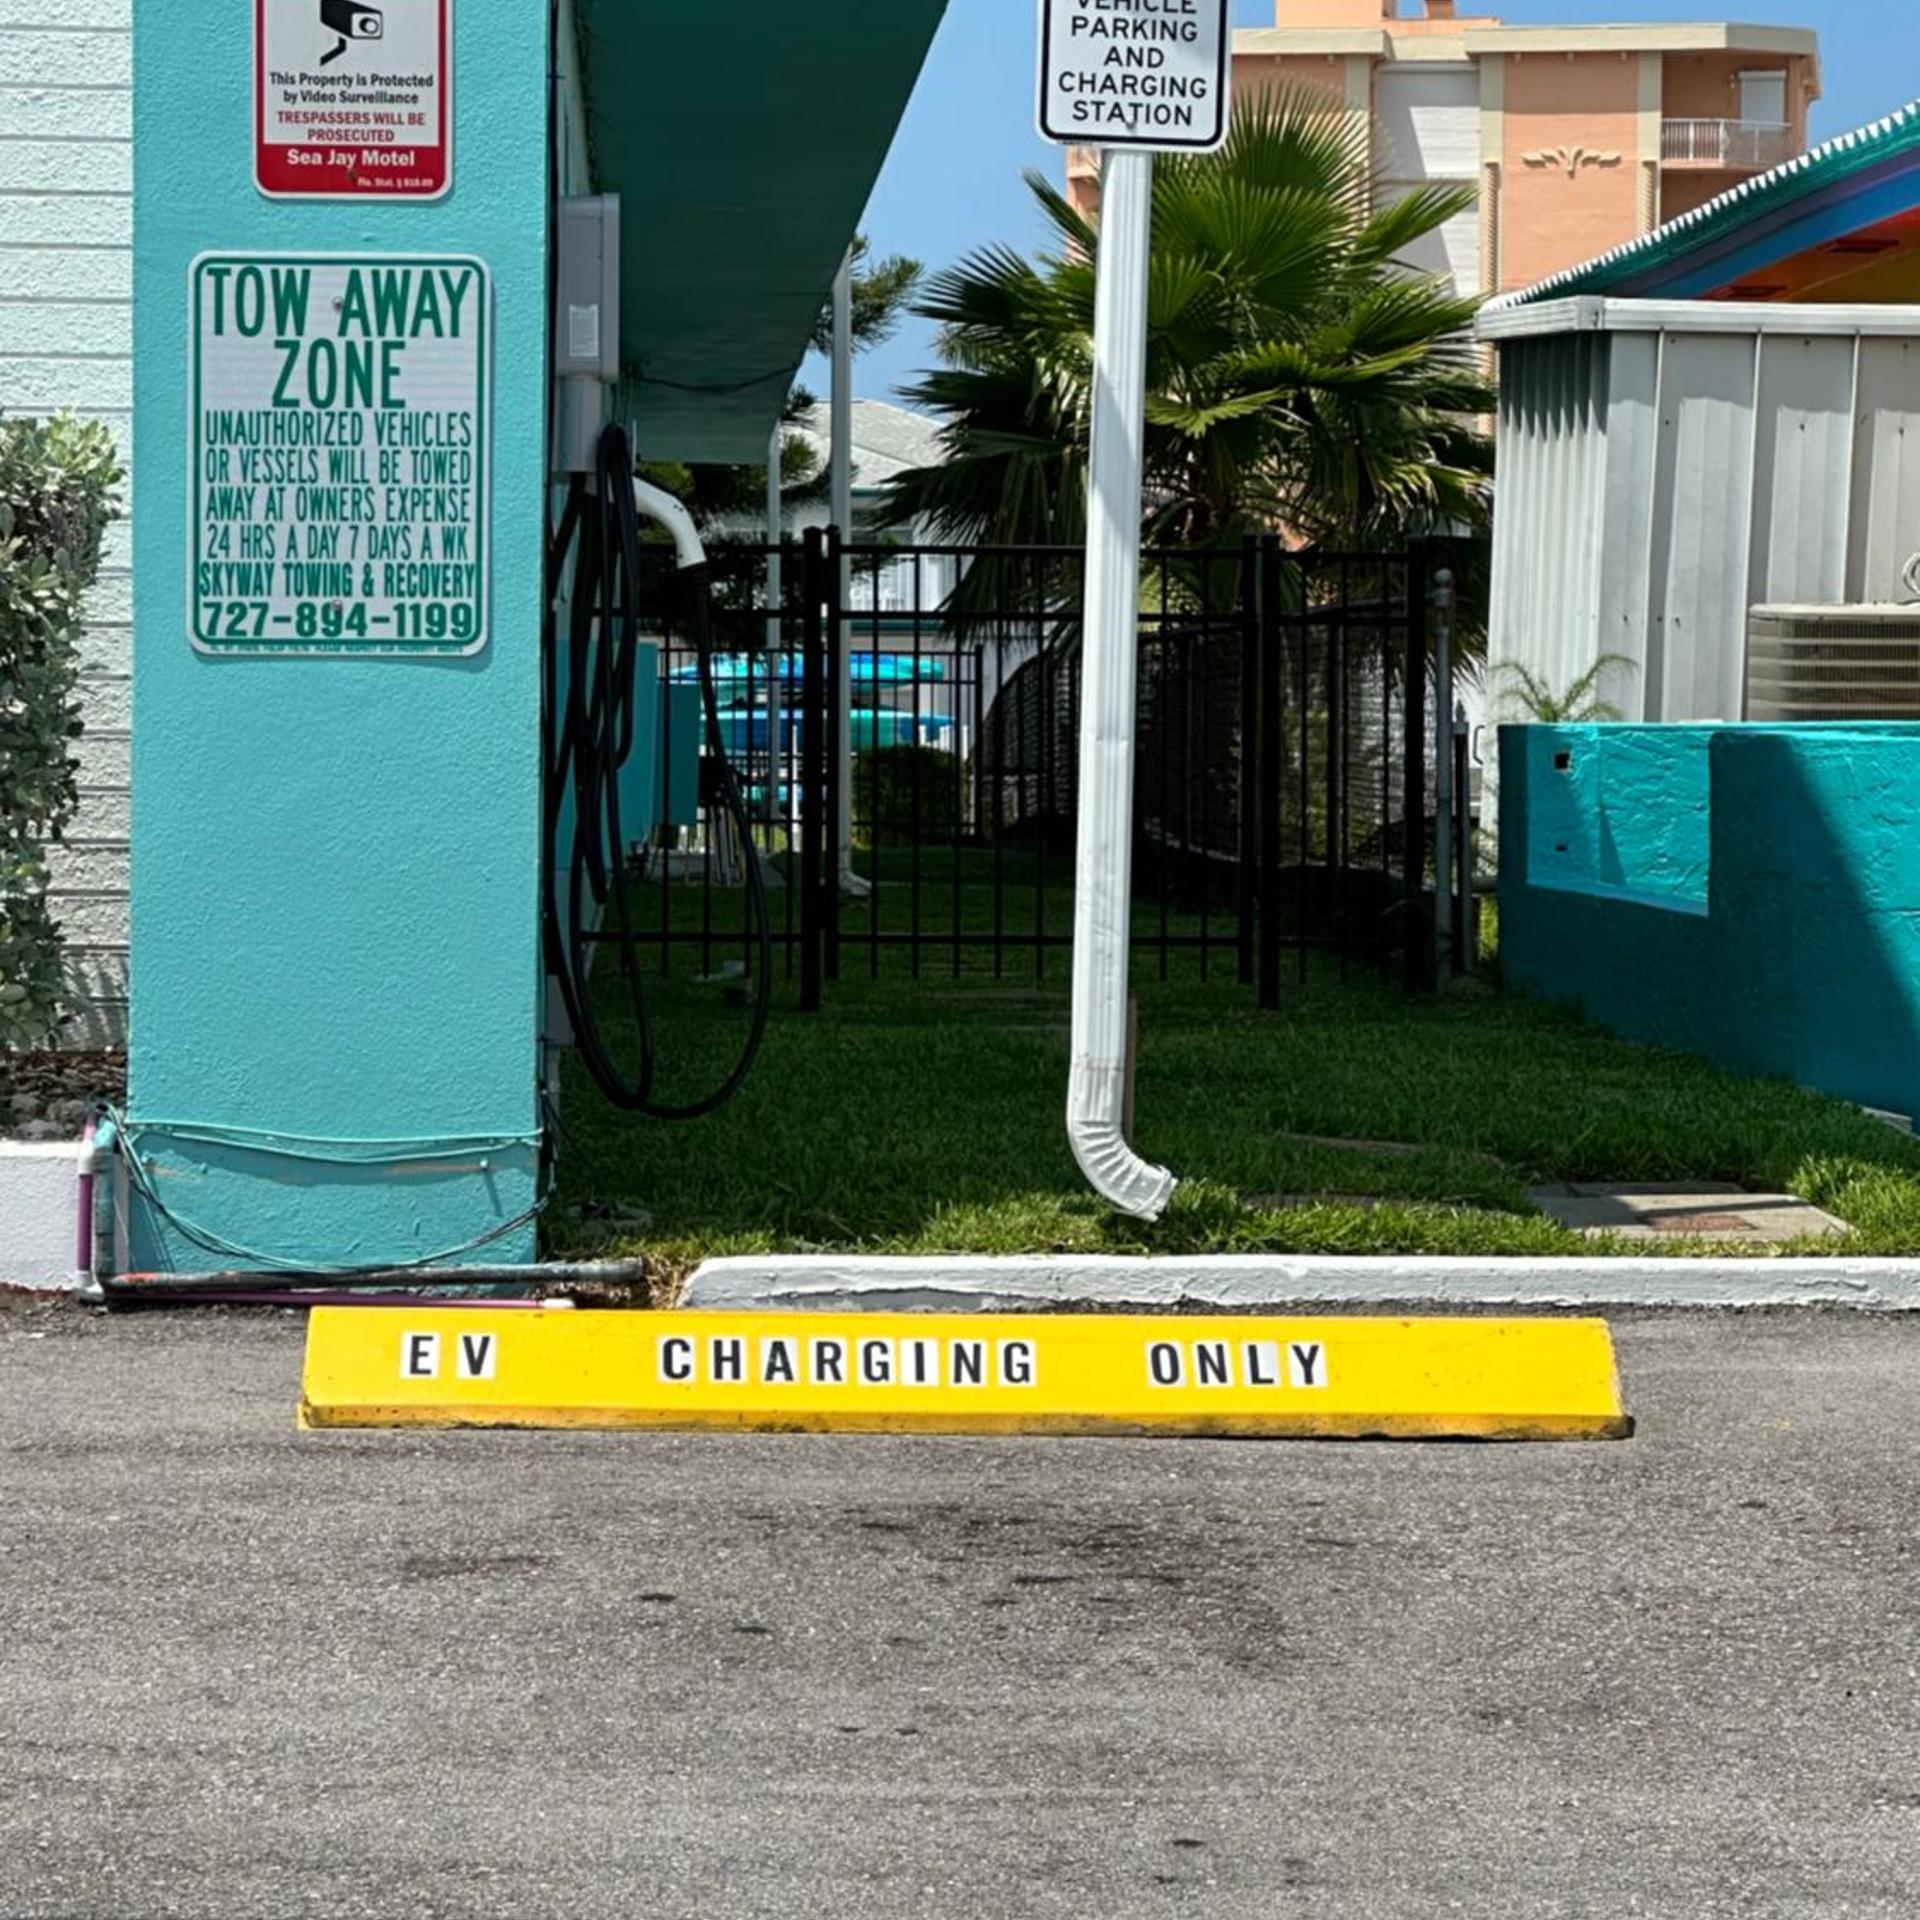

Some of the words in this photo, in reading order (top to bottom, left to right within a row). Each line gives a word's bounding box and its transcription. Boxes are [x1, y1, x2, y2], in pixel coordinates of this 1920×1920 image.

[1071, 15, 1198, 42] PARKING
[1104, 46, 1164, 68] AND
[270, 72, 296, 85] This
[299, 73, 353, 88] Property
[356, 74, 367, 86] is
[370, 74, 434, 87] Protected
[1058, 71, 1207, 98] CHARGING
[283, 90, 298, 104] by
[300, 91, 336, 103] Video
[339, 91, 419, 104] Surveillance
[278, 111, 370, 125] TRESPASSERS
[373, 113, 405, 126] WILL
[408, 113, 425, 126] BE
[1072, 100, 1192, 126] STATION
[307, 129, 395, 142] PROSECUTED
[287, 150, 322, 165] Sea
[327, 151, 356, 168] Jay
[361, 151, 415, 166] Motel
[206, 267, 311, 337] TOW
[337, 268, 472, 338] AWAY
[272, 338, 405, 409] ZONE
[206, 410, 363, 446] UNAUTHORIZED
[374, 411, 472, 447] VEHICLES
[206, 449, 230, 483] OR
[239, 449, 318, 484] VESSELS
[328, 449, 370, 484] WILL
[379, 450, 402, 485] BE
[411, 450, 471, 485] TOWED
[206, 487, 256, 521] AWAY
[265, 487, 286, 521] AT
[295, 487, 376, 522] OWNERS
[386, 487, 471, 522] EXPENSE
[207, 524, 231, 559] 24
[240, 525, 276, 559] HRS
[286, 525, 299, 559] A
[307, 525, 340, 560] DAY
[349, 525, 359, 560] 7
[368, 525, 412, 560] DAYS
[420, 526, 433, 560] A
[441, 526, 468, 560] WK
[200, 562, 275, 597] SKYWAY
[283, 562, 353, 597] TOWING
[361, 562, 374, 598] &
[384, 562, 475, 598] RECOVERY
[203, 601, 473, 638] 727-894-1199
[409, 1335, 491, 1375] EV
[661, 1337, 1031, 1384] CHARGING
[1150, 1343, 1319, 1385] ONLY
